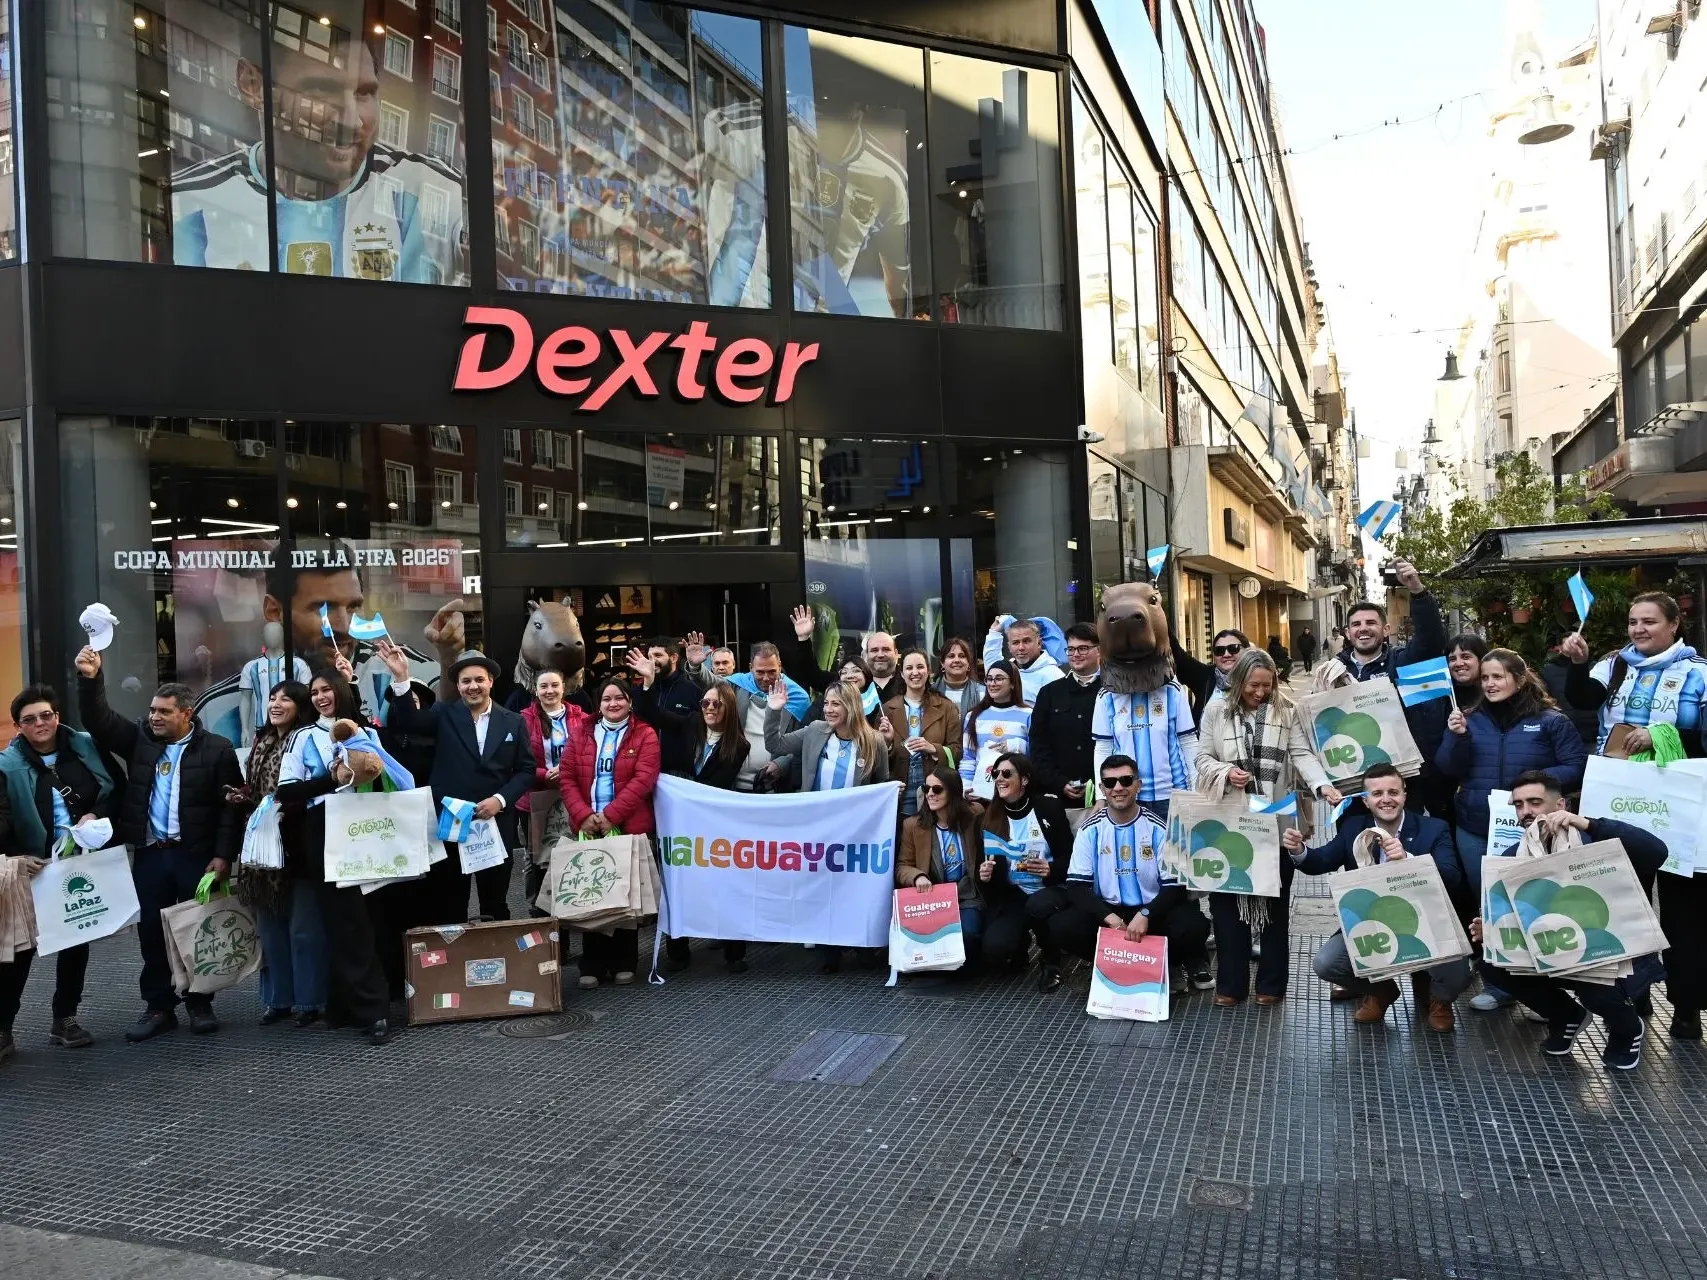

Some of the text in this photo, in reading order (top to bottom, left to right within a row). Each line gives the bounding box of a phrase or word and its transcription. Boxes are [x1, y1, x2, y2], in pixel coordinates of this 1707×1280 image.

[453, 306, 820, 411] Dexter
[114, 551, 172, 569] COPA
[177, 551, 275, 569] MUNDIAL
[291, 550, 317, 568] DE
[322, 549, 349, 567] LA
[354, 549, 397, 567] FIFA
[810, 583, 825, 592] 399
[600, 758, 614, 772] 10
[466, 839, 495, 852] TERMAS
[1568, 858, 1605, 872] Bienestar
[558, 871, 588, 892] Entre
[1386, 872, 1418, 883] Bienestar
[904, 901, 951, 913] Gualeguay
[911, 910, 931, 918] espera
[194, 937, 227, 964] Entre
[1104, 947, 1157, 965] Gualeguay
[1110, 957, 1132, 965] espera
